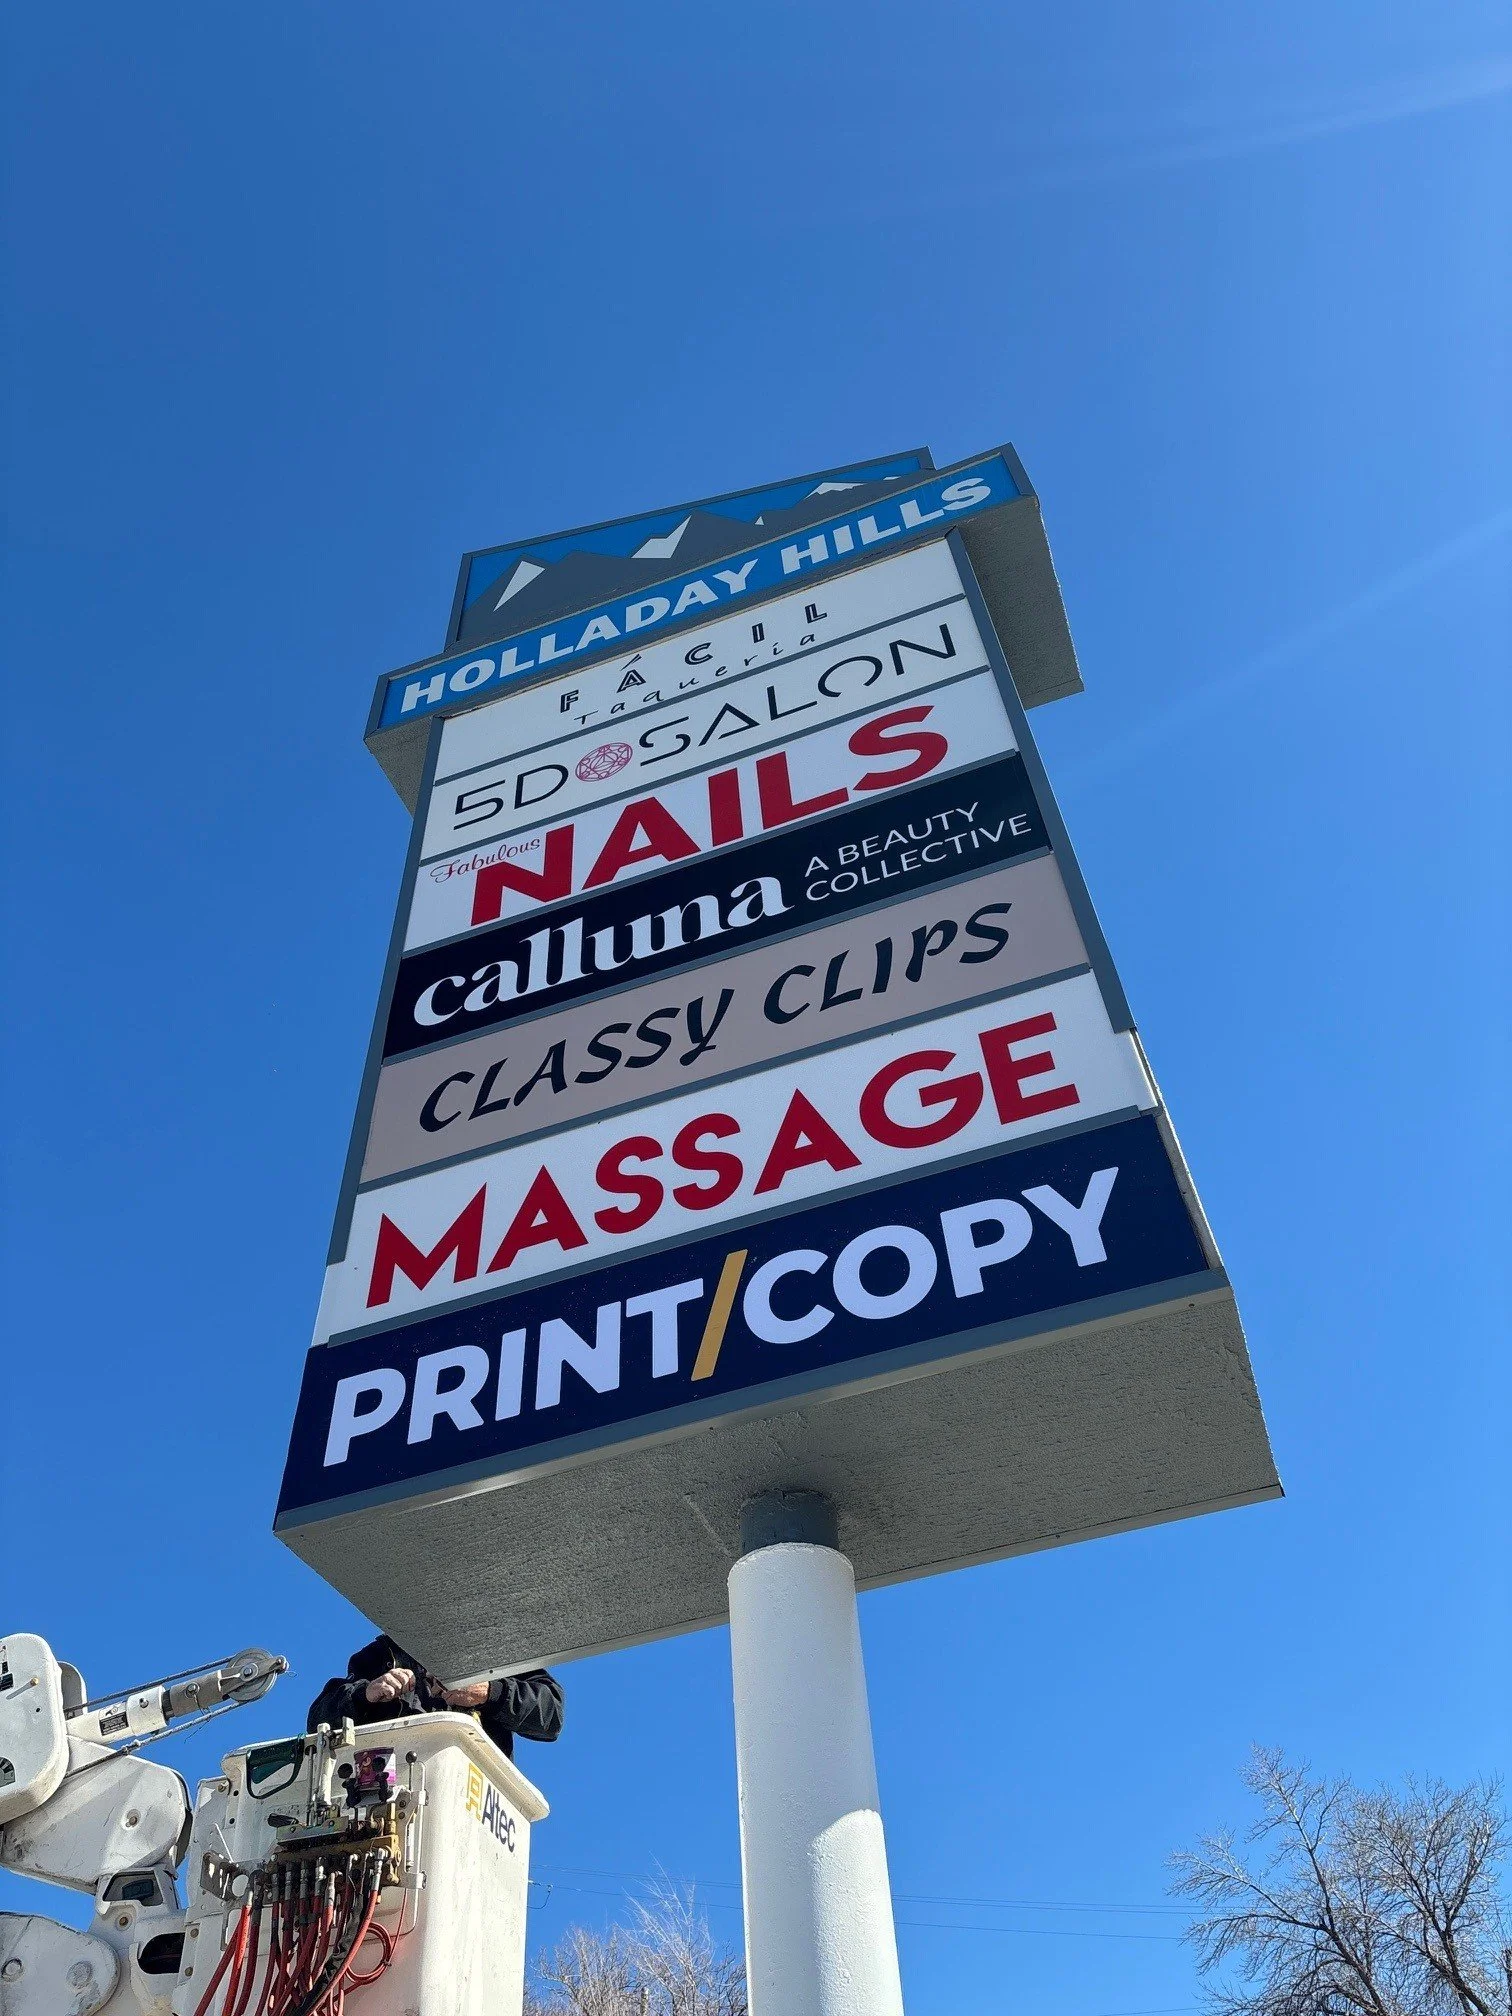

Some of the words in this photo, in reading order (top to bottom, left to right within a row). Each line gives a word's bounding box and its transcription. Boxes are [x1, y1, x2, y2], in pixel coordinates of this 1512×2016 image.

[401, 560, 757, 714] HOLLADAY
[781, 476, 992, 575] HILLS
[453, 764, 569, 830] 5D
[639, 624, 957, 766] SALON
[470, 704, 949, 926] NAILS
[430, 838, 541, 884] Fabulous
[805, 856, 829, 877] A
[838, 801, 979, 866] BEAUTY
[806, 813, 1032, 901] COLLECTIVE
[413, 874, 795, 1026] calluna
[419, 989, 733, 1133] CLASSY
[763, 902, 1013, 1026] CLIPS
[366, 1012, 1079, 1308] MASSAGE
[322, 1166, 1119, 1467] PRINT/COPY
[481, 1783, 516, 1853] Altec
